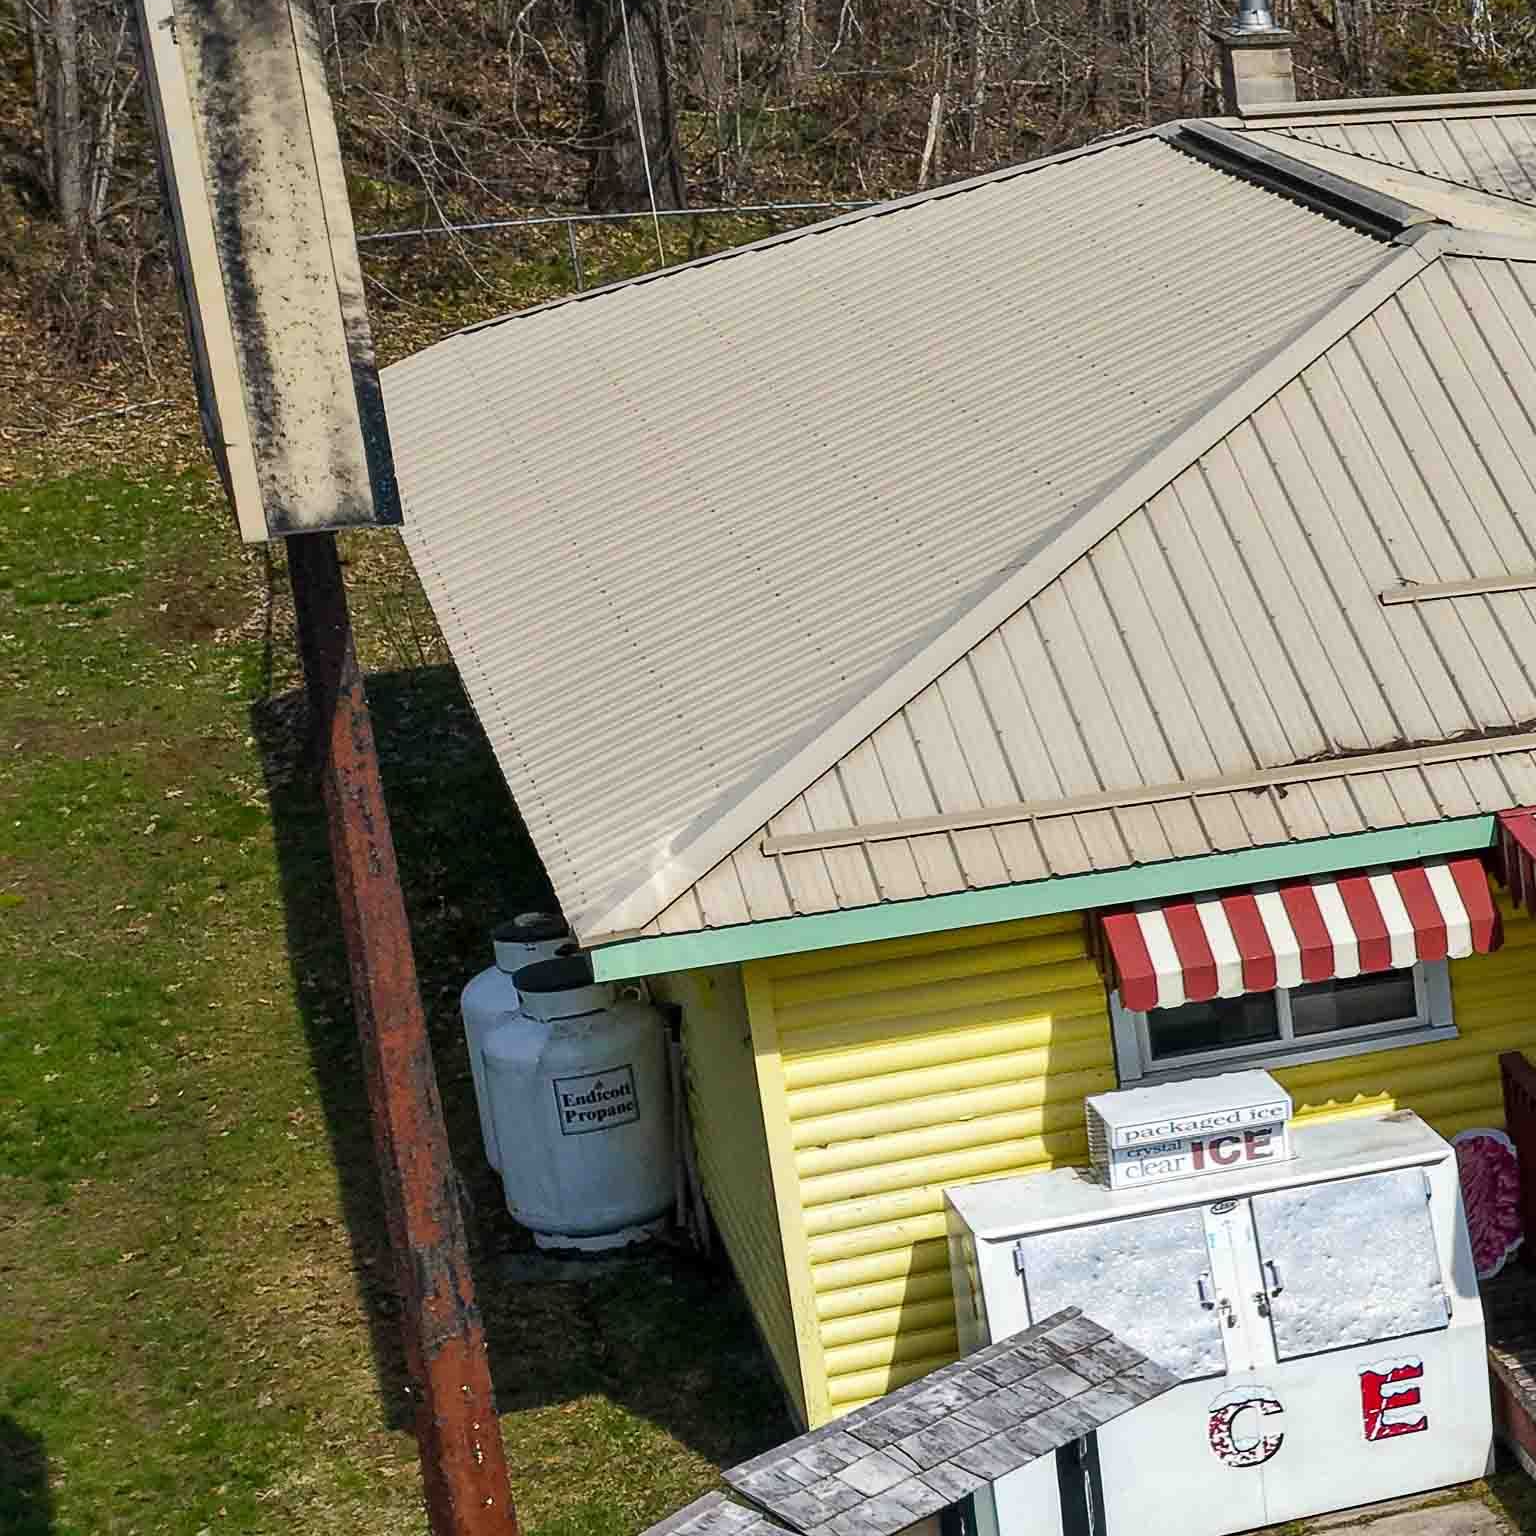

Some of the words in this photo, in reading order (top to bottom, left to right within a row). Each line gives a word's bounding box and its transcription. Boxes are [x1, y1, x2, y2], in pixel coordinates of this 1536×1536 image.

[561, 1081, 632, 1107] Endicott
[564, 1101, 633, 1124] Propane
[1124, 1110, 1242, 1144] packaged
[1249, 1106, 1284, 1122] ice
[1127, 1139, 1184, 1159] crystal
[1191, 1127, 1275, 1171] ICE
[1125, 1154, 1186, 1180] clear
